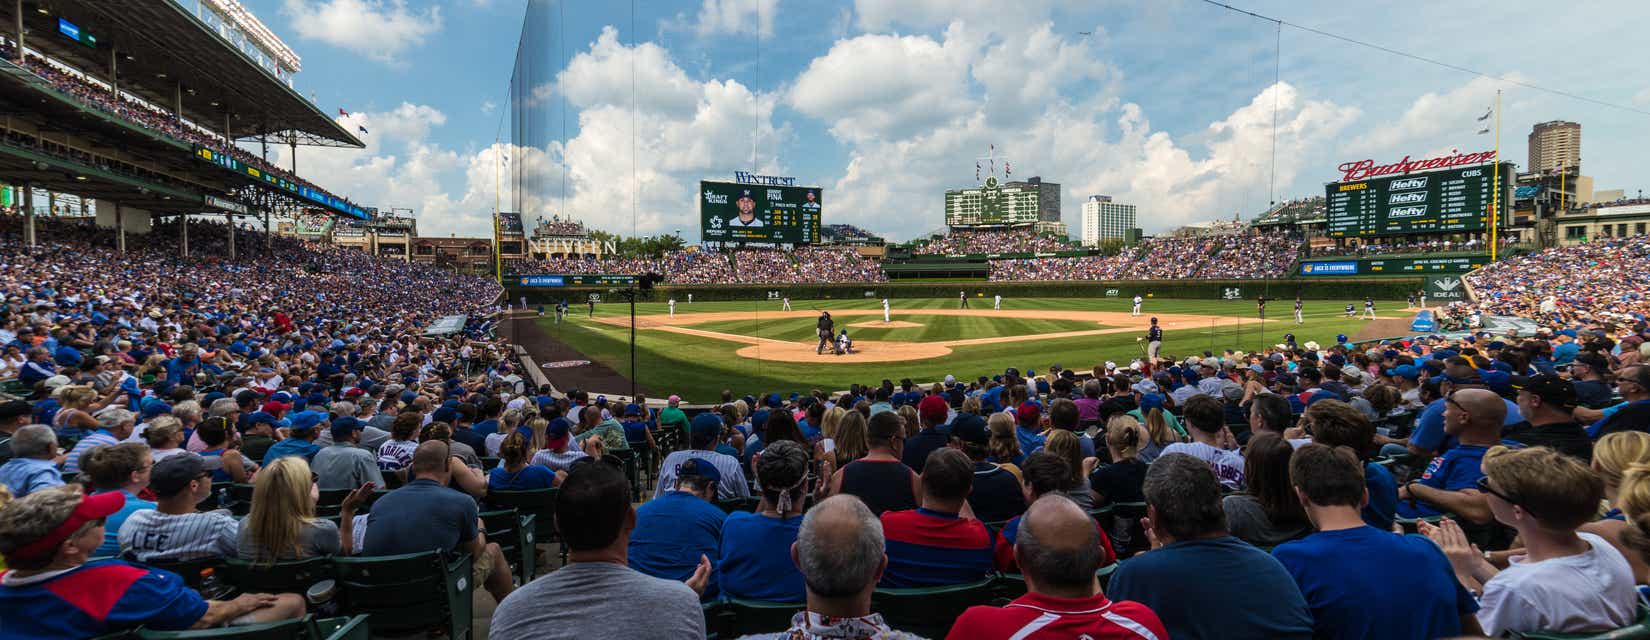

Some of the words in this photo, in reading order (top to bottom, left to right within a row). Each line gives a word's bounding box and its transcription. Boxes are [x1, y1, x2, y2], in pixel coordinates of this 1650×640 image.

[1338, 149, 1497, 181] Budweiser
[735, 170, 796, 186] WINTRUST
[1462, 169, 1482, 178] CUBS
[1339, 183, 1368, 191] BREWERS
[1391, 180, 1425, 189] Hefty
[1391, 194, 1425, 203] Hefty
[1391, 207, 1425, 216] Hefty
[527, 239, 619, 255] NUVEEN
[132, 530, 169, 552] LEE
